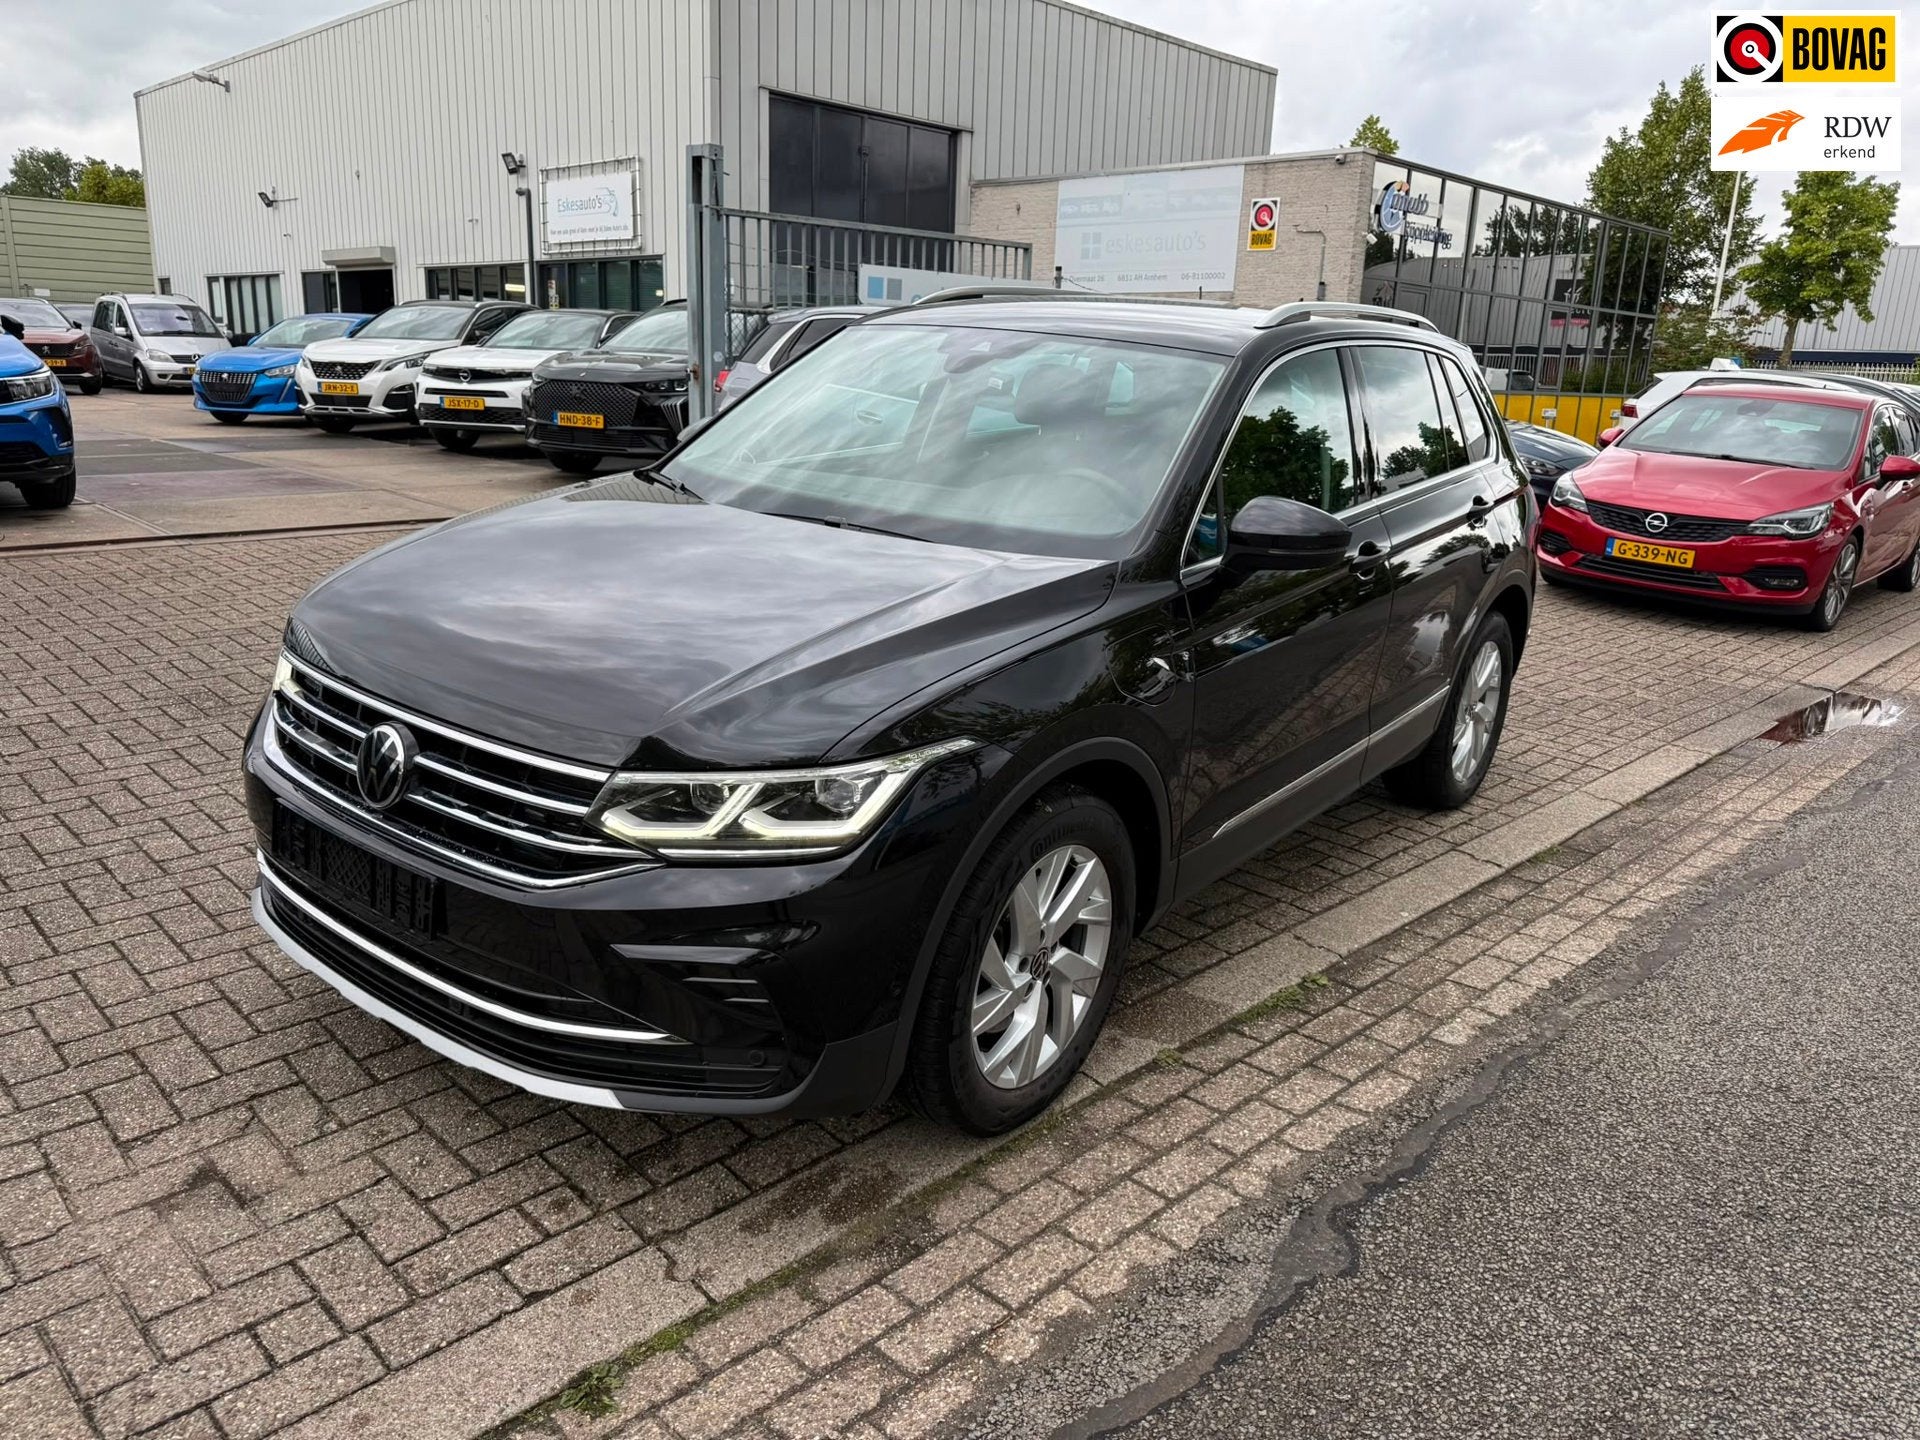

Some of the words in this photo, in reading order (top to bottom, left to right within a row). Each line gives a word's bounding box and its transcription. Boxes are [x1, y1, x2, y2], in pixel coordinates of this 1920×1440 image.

[557, 194, 603, 213] Eskesauto's
[1104, 231, 1208, 254] eskesauto's
[1251, 233, 1273, 246] BOVAG
[448, 398, 480, 409] JSX-17-D
[559, 414, 601, 427] HND-38-F
[1617, 542, 1689, 565] G-339-NG
